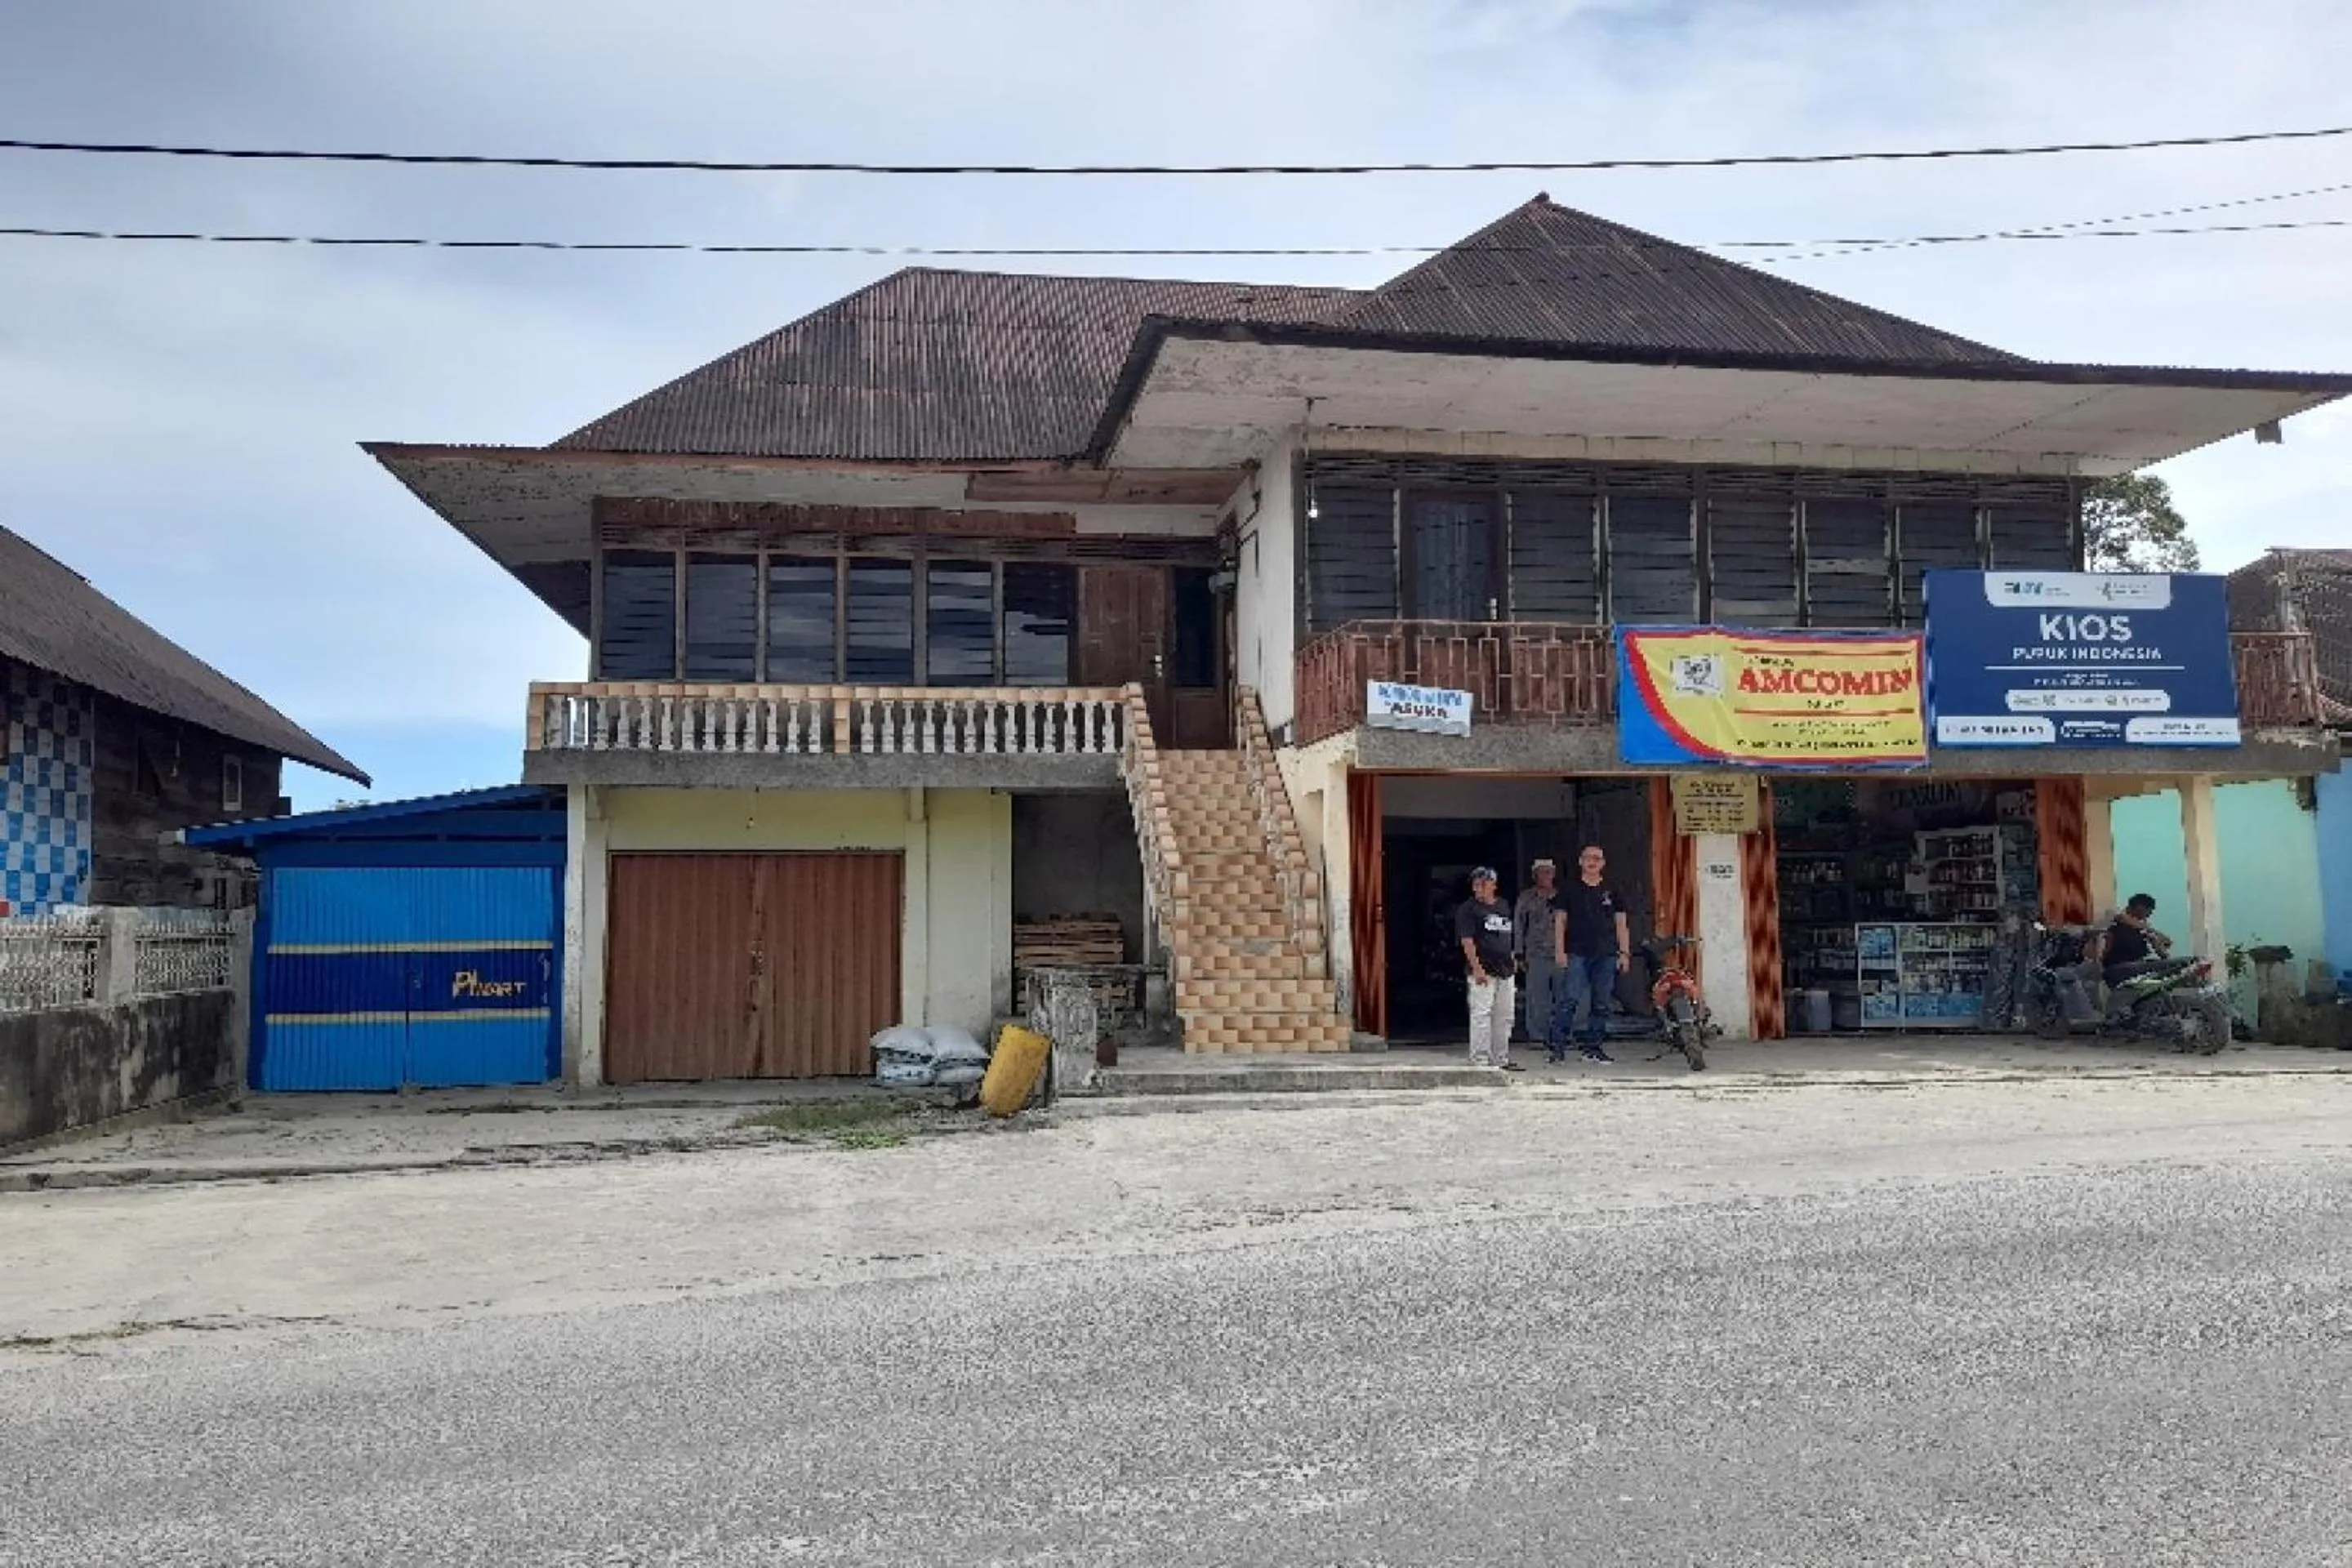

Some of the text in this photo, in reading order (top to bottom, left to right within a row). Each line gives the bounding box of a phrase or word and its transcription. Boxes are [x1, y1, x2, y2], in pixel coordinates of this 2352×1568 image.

[2039, 614, 2132, 642] KIOS
[2012, 646, 2162, 660] PUPUK INDONESIA
[1736, 666, 1913, 696] AMCOMIN
